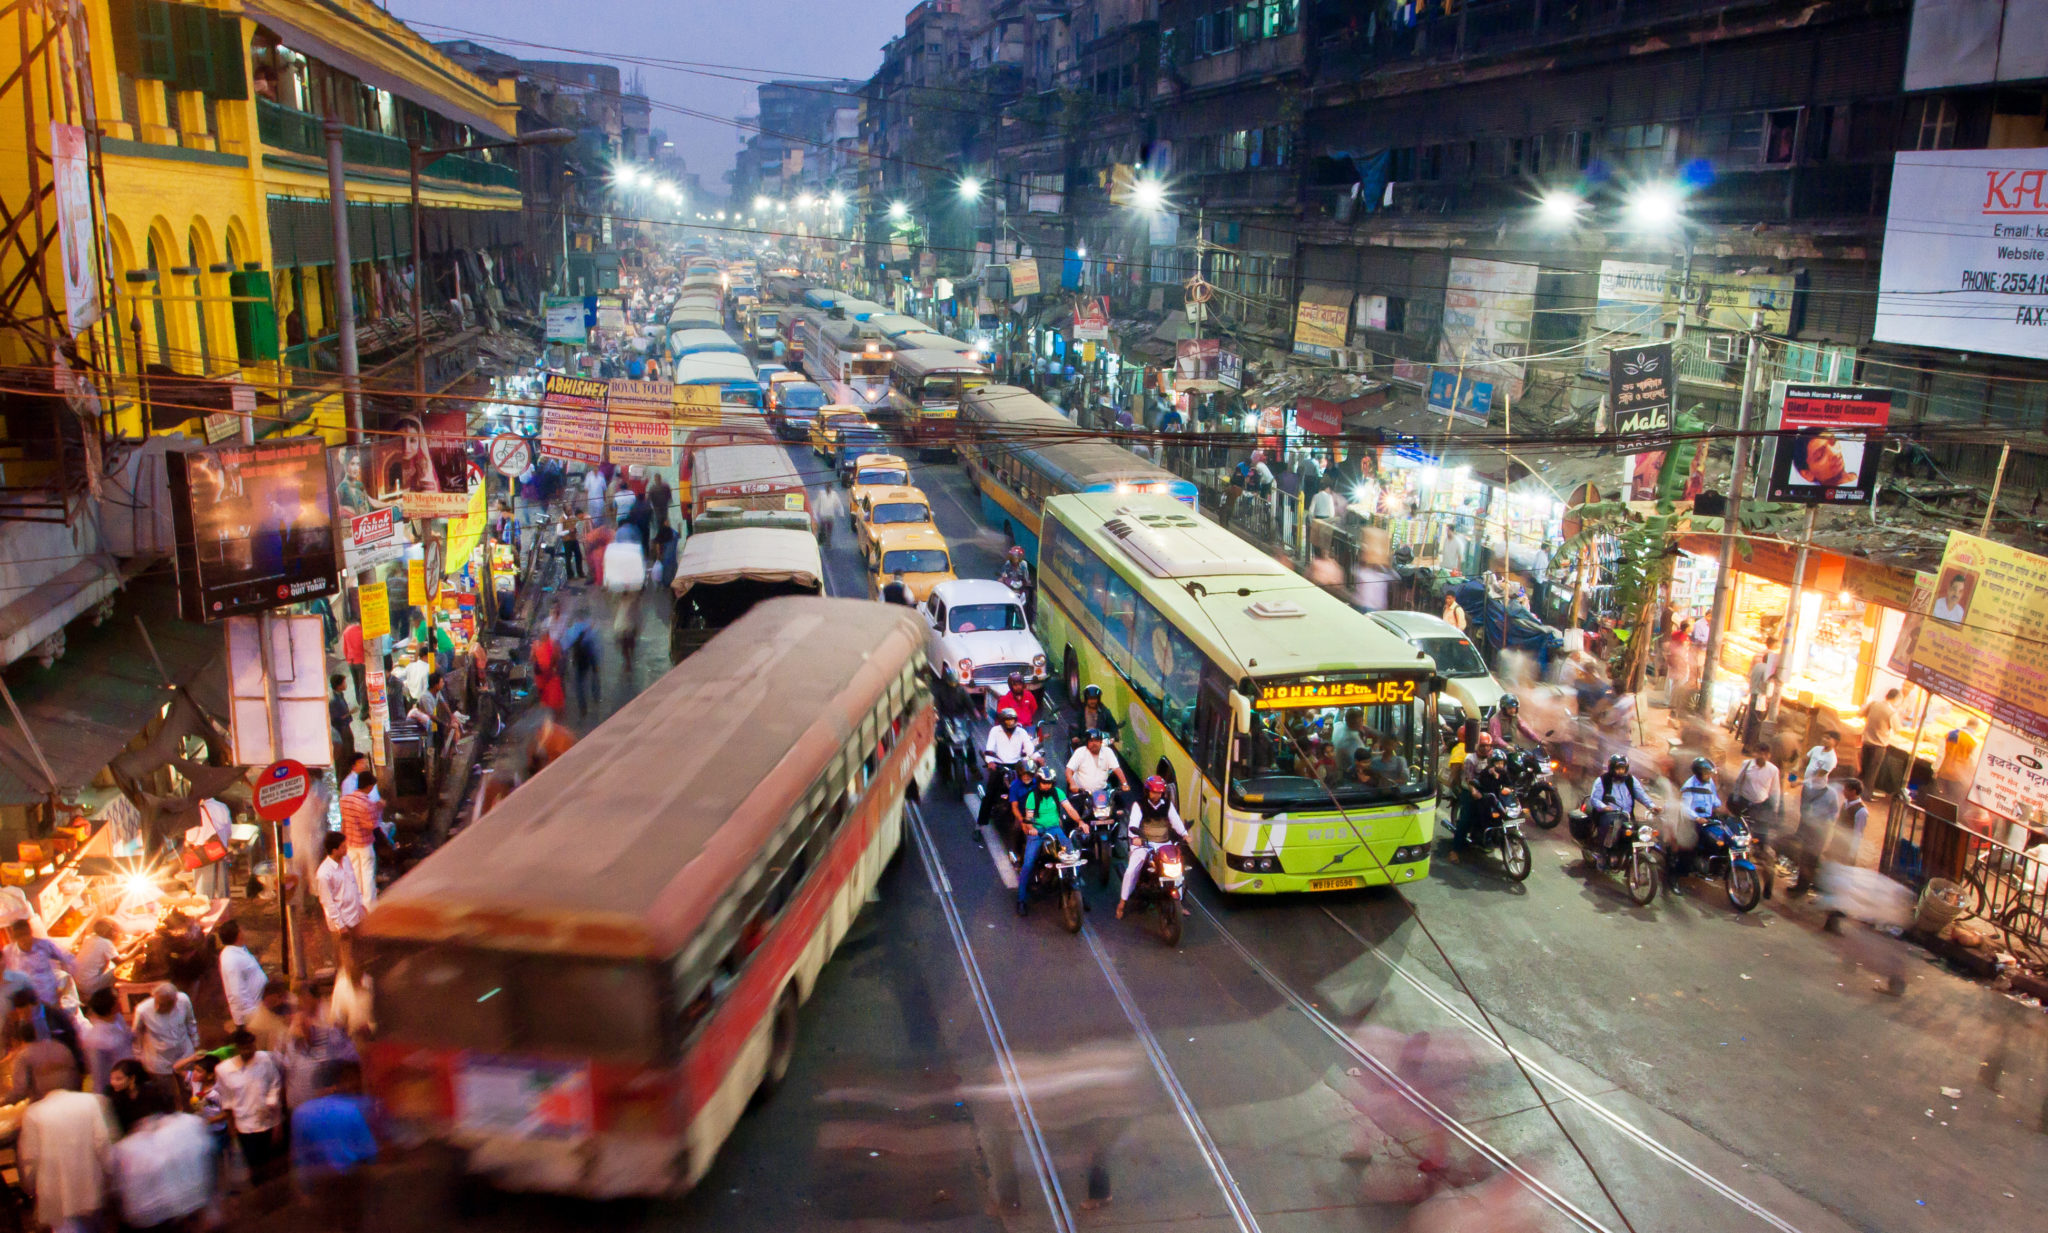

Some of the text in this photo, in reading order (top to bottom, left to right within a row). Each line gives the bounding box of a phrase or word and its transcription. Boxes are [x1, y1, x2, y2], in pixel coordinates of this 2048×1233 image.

[1984, 170, 2048, 209] KA
[546, 375, 609, 397] ABHISHEK
[611, 382, 672, 396] ROYAL TOUCH
[613, 421, 669, 439] Raymond
[1619, 407, 1668, 436] Mala
[354, 512, 391, 540] Ashok
[291, 582, 326, 597] QUIT TODAY
[1307, 825, 1374, 841] WBSTC
